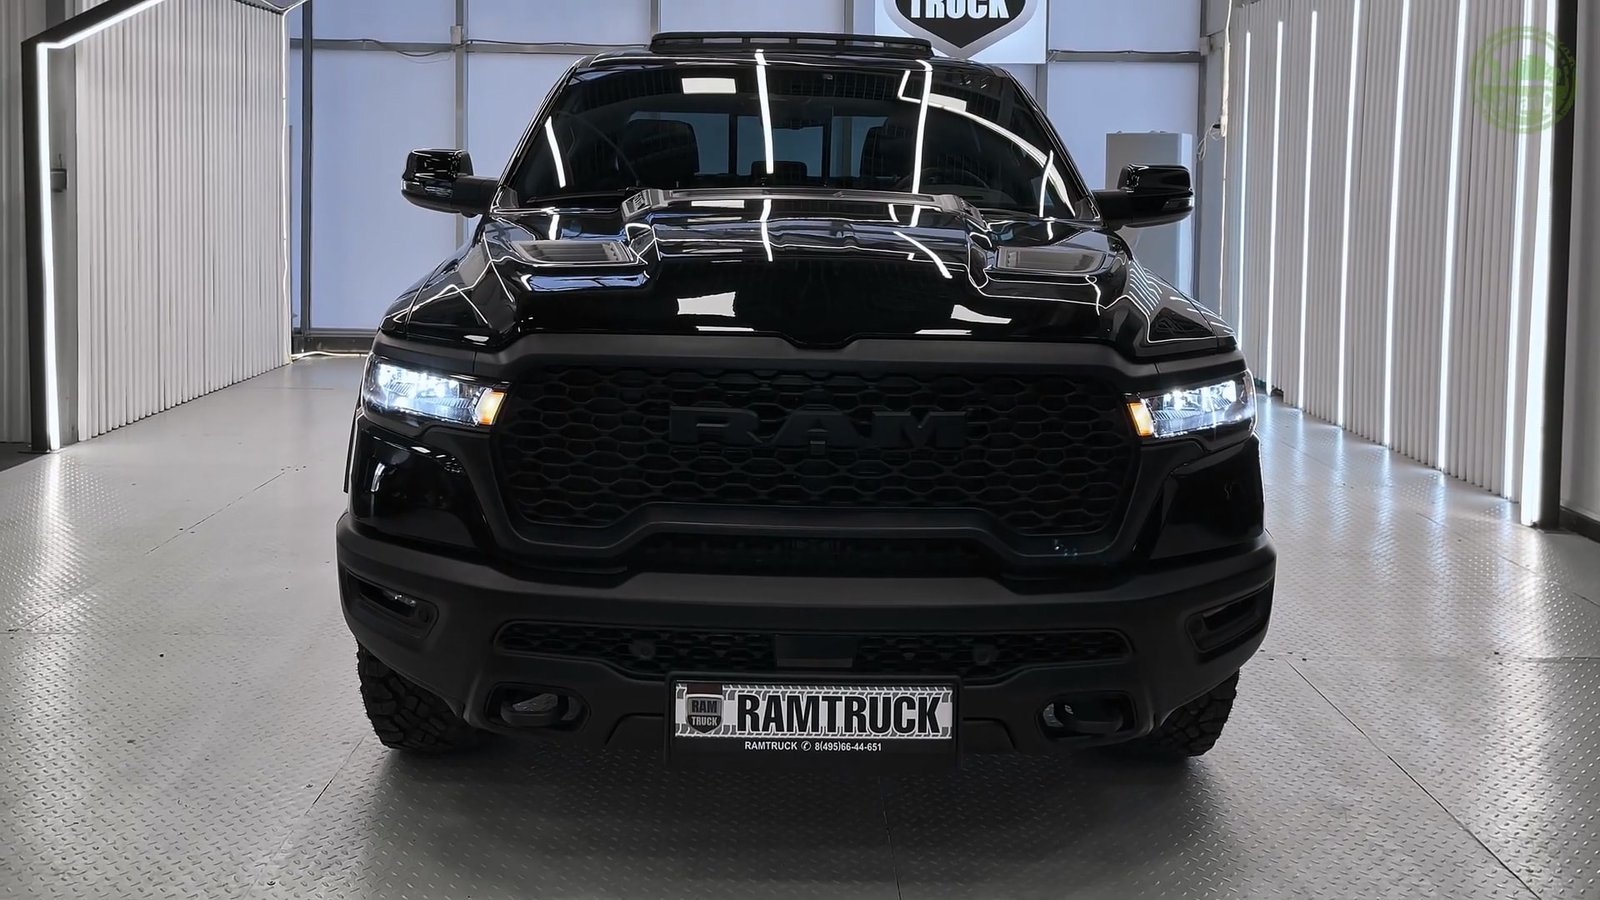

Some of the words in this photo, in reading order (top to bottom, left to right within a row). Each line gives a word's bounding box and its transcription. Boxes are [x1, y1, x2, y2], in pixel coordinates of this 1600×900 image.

[669, 405, 967, 449] RAM
[691, 700, 718, 713] RAM
[737, 694, 941, 734] RAMTRUCK
[691, 716, 718, 726] TRUCK
[744, 741, 798, 750] RAMTRUCK
[814, 741, 882, 751] 8(495)66-44-651
